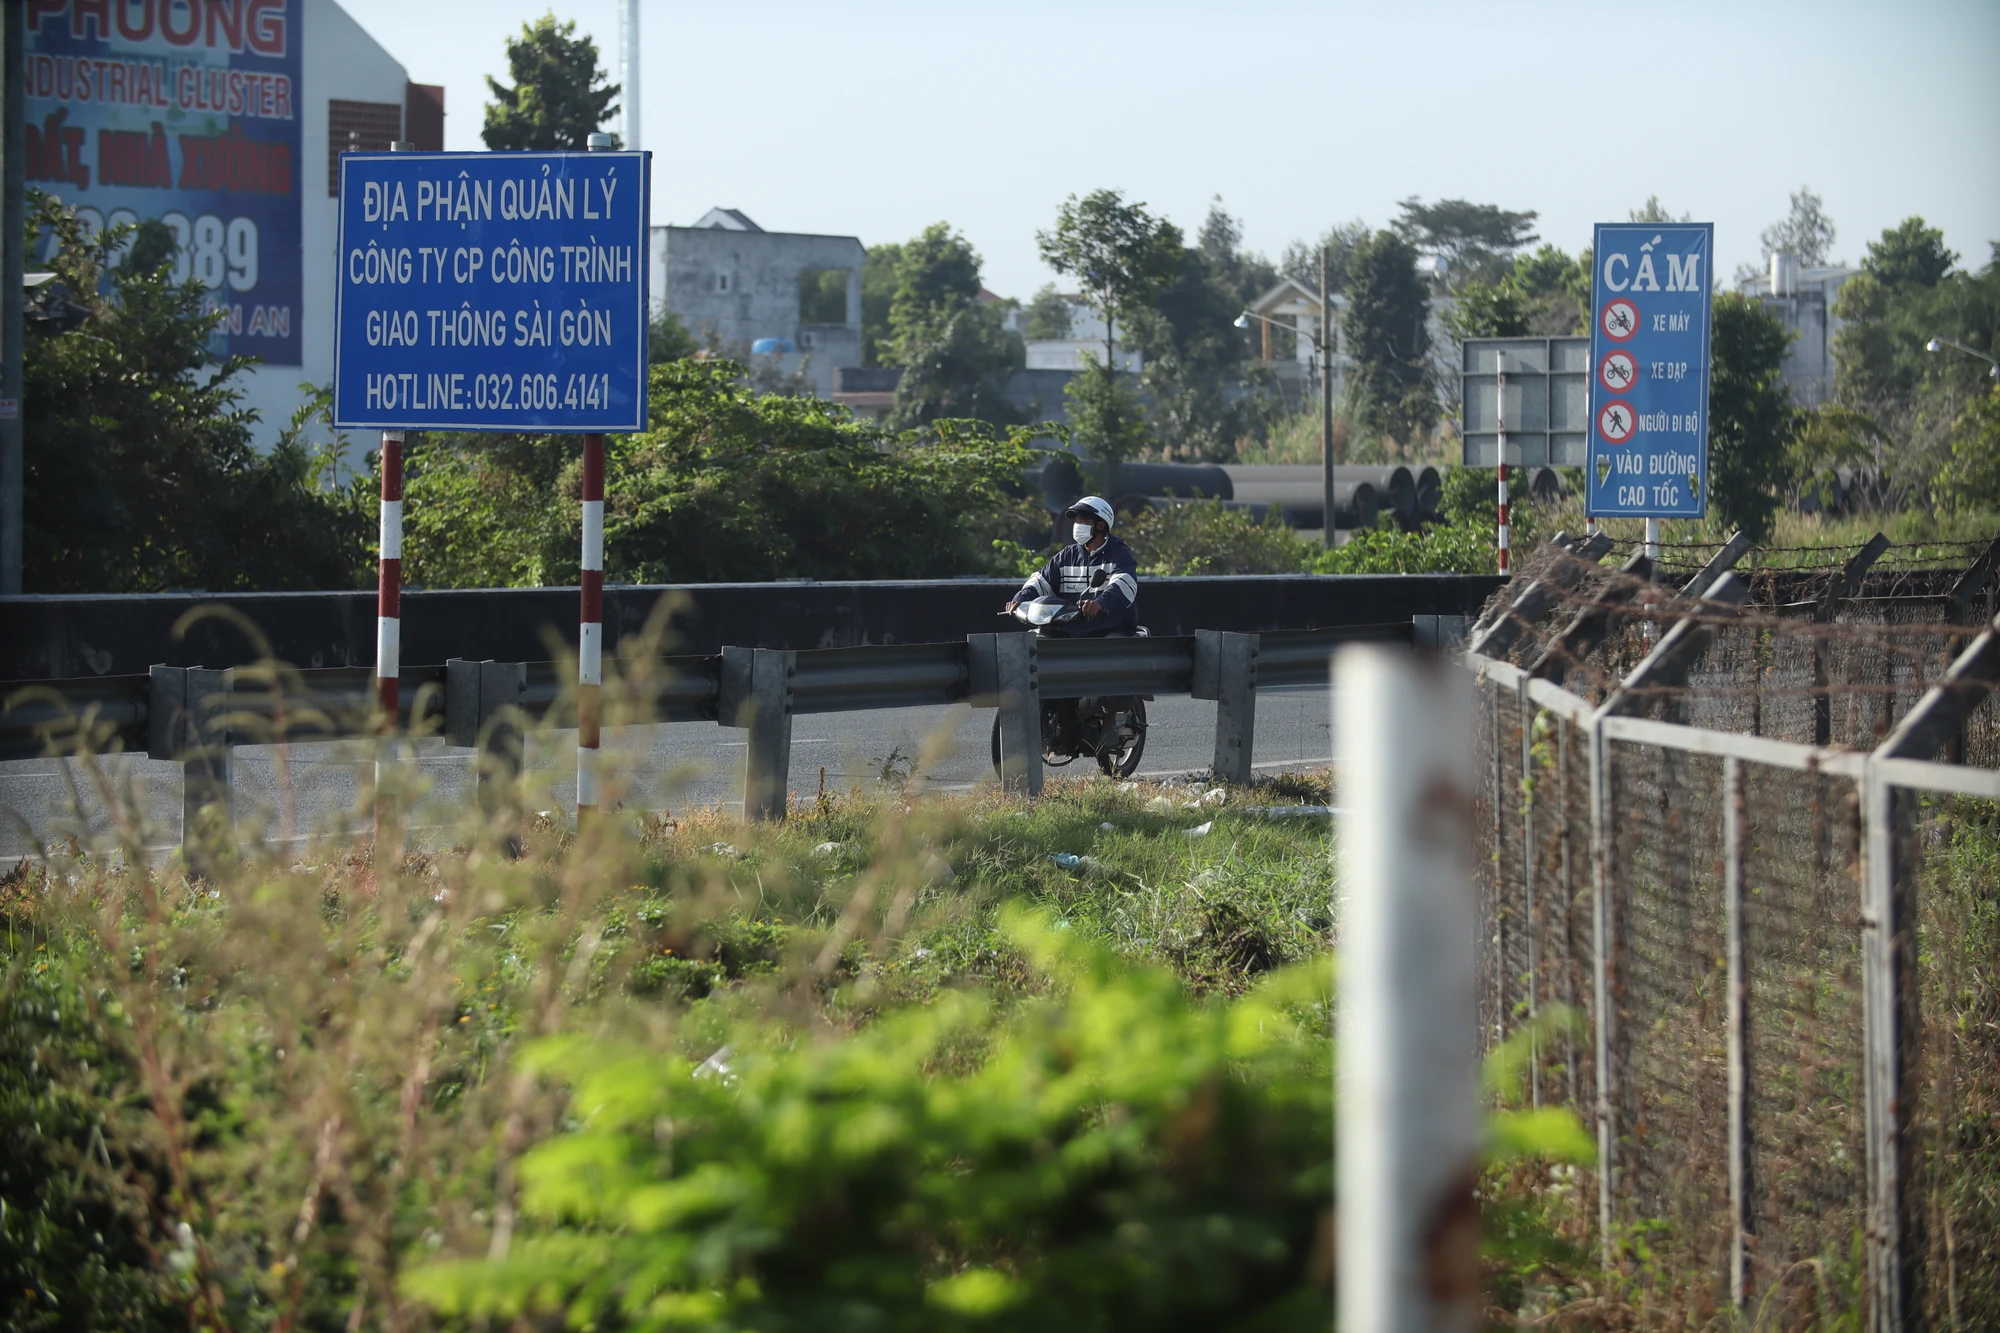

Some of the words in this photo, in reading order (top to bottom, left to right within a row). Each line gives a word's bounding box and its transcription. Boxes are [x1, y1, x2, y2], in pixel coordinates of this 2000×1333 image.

[177, 67, 293, 118] CLUSTER
[363, 181, 409, 231] ĐỊA
[417, 170, 492, 230] PHẬN
[500, 164, 573, 220] QUẢN
[583, 166, 617, 220] LÝ
[349, 239, 412, 284] CÔNG
[418, 247, 448, 284] TY
[453, 246, 484, 284] CP
[491, 238, 555, 284] CÔNG
[560, 235, 631, 283] TRÌNH
[1603, 233, 1700, 293] CẤM
[247, 304, 291, 338] AN
[366, 309, 418, 347] GIAO
[427, 300, 506, 347] THÔNG
[513, 299, 552, 347] SÀI
[559, 298, 612, 347] GÒN
[1653, 314, 1666, 332] XE
[1669, 310, 1690, 332] MÁY
[1651, 361, 1664, 379] XE
[1667, 362, 1687, 383] ĐẠP
[1638, 409, 1669, 432] NGƯỜI
[1672, 414, 1682, 432] ĐI
[1685, 411, 1698, 435] BỘ
[1616, 449, 1643, 475] VÀO
[1649, 449, 1696, 475] ĐƯỜNG
[1618, 485, 1646, 507] CAO
[1652, 478, 1679, 507] TỐC
